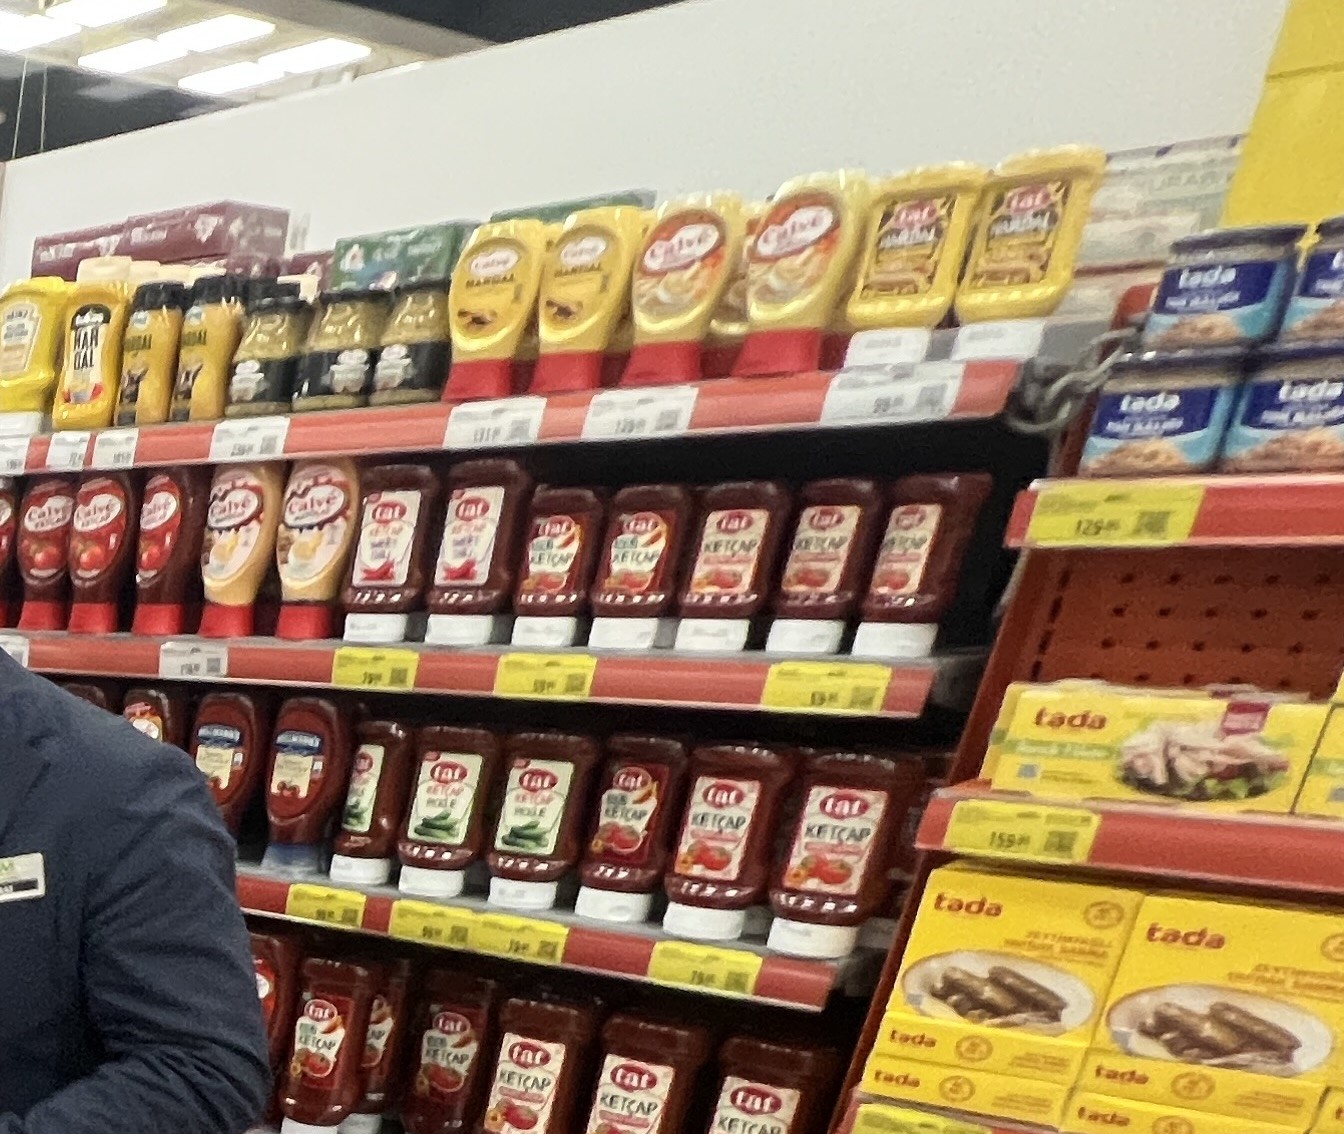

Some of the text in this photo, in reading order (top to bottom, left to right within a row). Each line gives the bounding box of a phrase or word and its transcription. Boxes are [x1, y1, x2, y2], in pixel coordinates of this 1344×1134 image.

[1279, 381, 1344, 401] tada
[1120, 391, 1181, 413] tada
[374, 504, 401, 520] tat
[458, 500, 486, 519] tat
[718, 516, 748, 531] tat
[703, 539, 757, 557] KETÇAP
[794, 536, 848, 553] KETÇAP
[1034, 707, 1108, 732] tada
[435, 765, 462, 781] tat
[524, 773, 550, 787] tat
[618, 773, 643, 786] tat
[706, 788, 737, 806] tat
[824, 798, 862, 815] tat
[604, 807, 648, 822] KETÇAP
[692, 812, 747, 834] KETÇAP
[805, 823, 872, 844] KETÇAP
[933, 891, 1004, 919] tada
[1145, 922, 1227, 951] tada
[308, 1003, 331, 1018] tat
[438, 1019, 463, 1034] tat
[298, 1035, 336, 1051] KETÇAP
[887, 1027, 937, 1050] tada
[424, 1049, 470, 1065] KETÇAP
[513, 1045, 546, 1066] tat
[499, 1070, 552, 1093] KETÇAP
[613, 1067, 653, 1088] tat
[873, 1068, 921, 1090] tada
[1094, 1063, 1150, 1087] tada
[598, 1092, 658, 1118] KETÇAP
[733, 1089, 777, 1113] tat
[1076, 1105, 1131, 1129] tada
